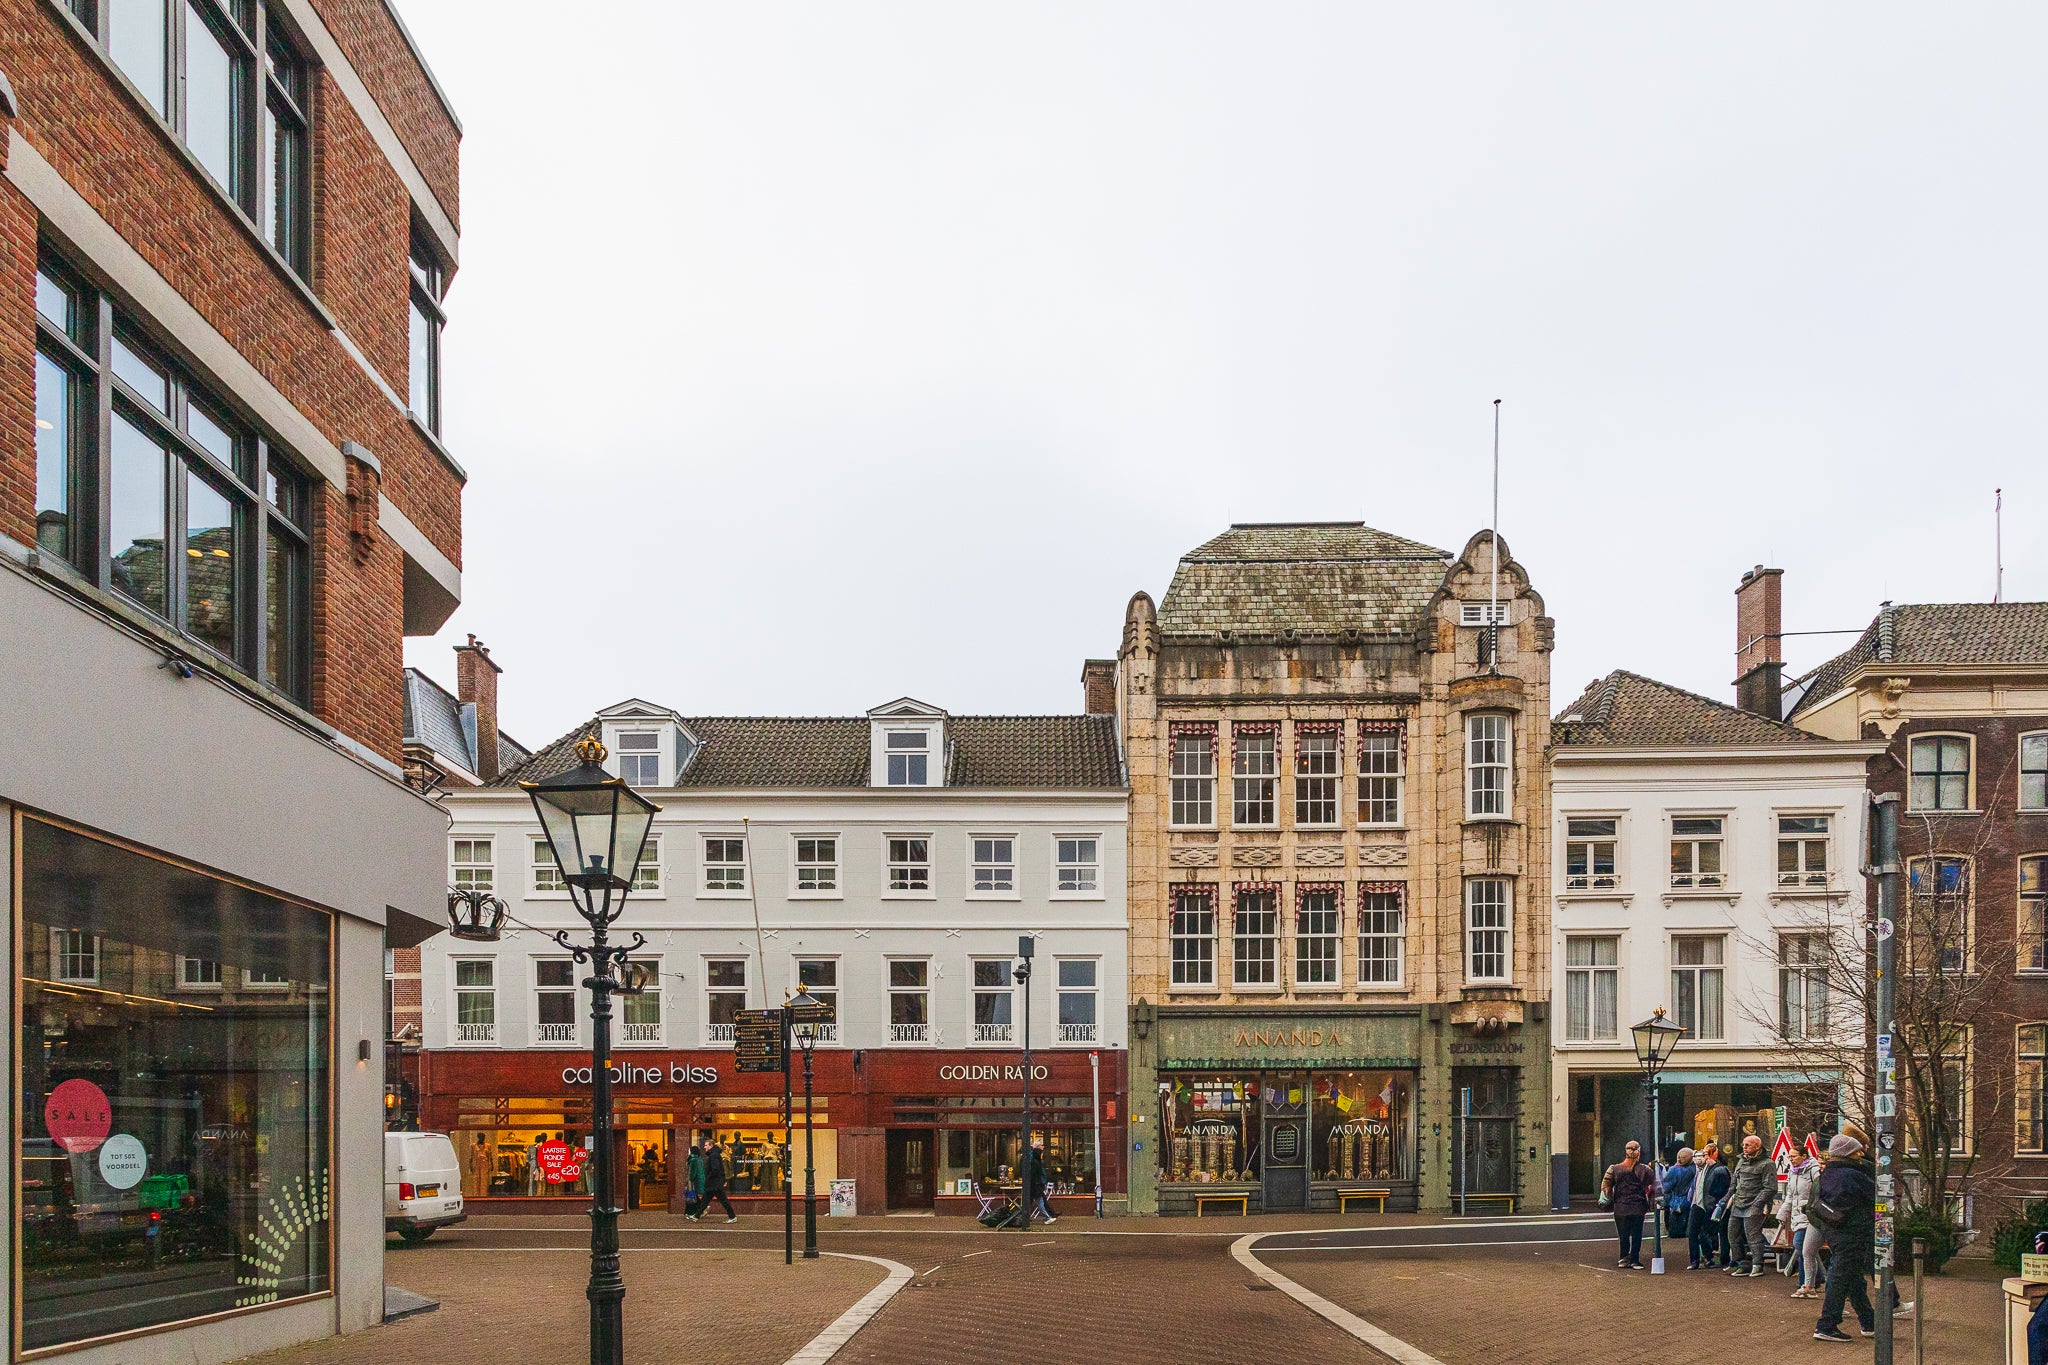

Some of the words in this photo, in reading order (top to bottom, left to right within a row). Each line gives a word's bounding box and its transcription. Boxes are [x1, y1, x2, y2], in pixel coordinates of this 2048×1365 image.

[1236, 1029, 1341, 1047] ANANDA
[562, 1061, 662, 1084] caoline
[940, 1065, 999, 1080] GOLDEN
[1004, 1065, 1048, 1080] RAIO
[52, 1109, 106, 1122] SALE
[1183, 1125, 1238, 1136] ANANDA
[561, 1165, 580, 1176] €20
